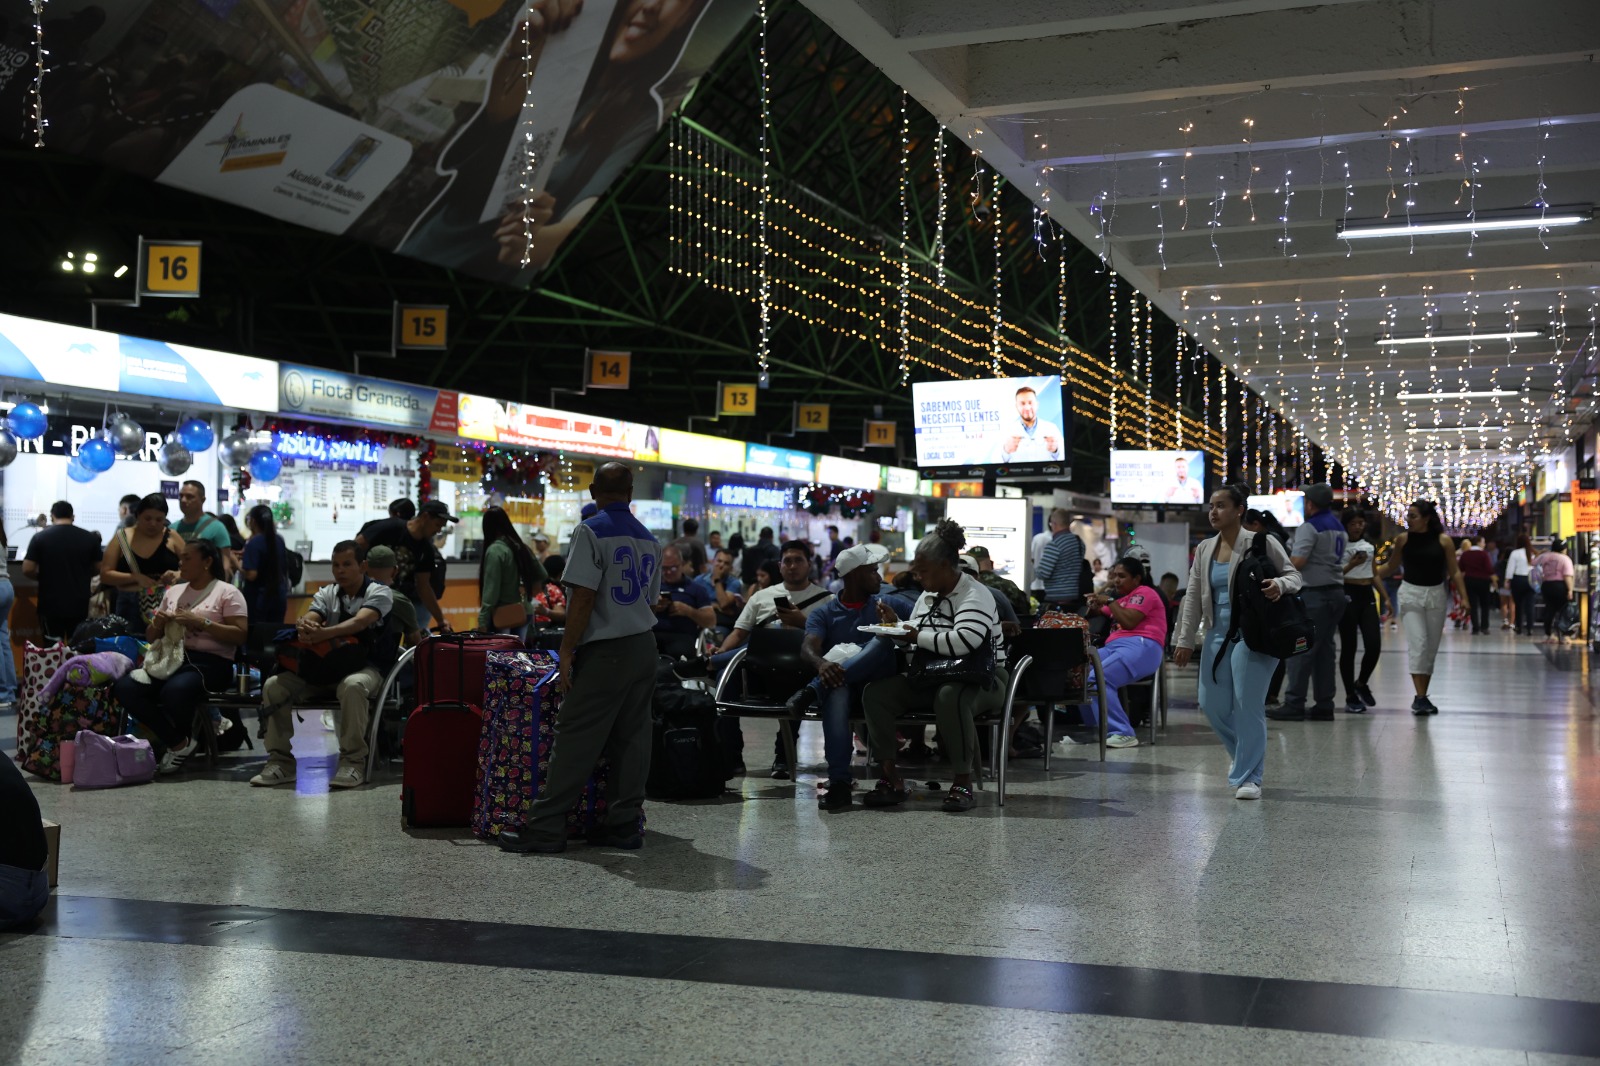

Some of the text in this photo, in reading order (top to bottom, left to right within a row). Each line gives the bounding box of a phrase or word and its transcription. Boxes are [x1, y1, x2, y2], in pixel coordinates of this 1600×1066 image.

[159, 256, 188, 281] 16
[412, 317, 436, 337] 15
[600, 361, 621, 378] 14
[312, 378, 420, 411] Flota Granada
[731, 392, 748, 406] 13
[920, 399, 982, 413] SABEMOS QUE
[806, 411, 821, 424] 12
[921, 411, 1000, 425] NECESITAS LENTES
[876, 428, 888, 440] 11
[924, 452, 941, 461] LOCAL
